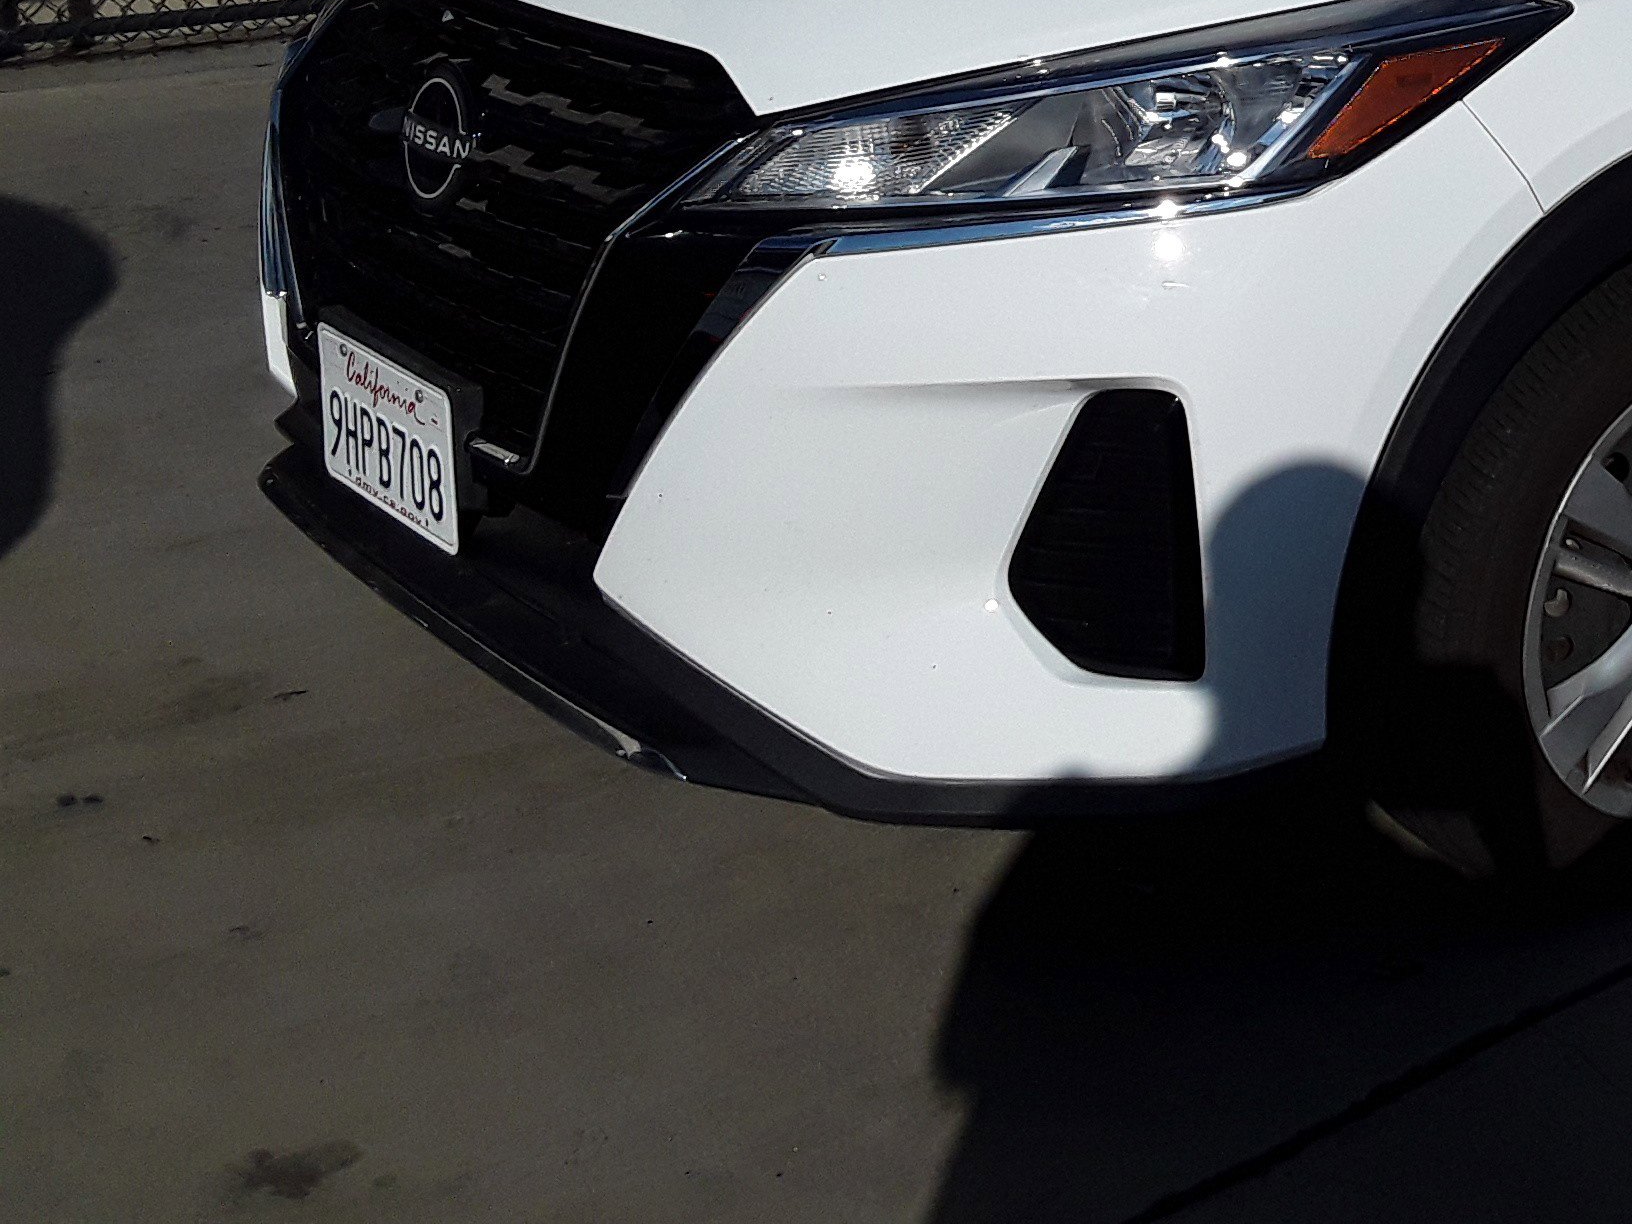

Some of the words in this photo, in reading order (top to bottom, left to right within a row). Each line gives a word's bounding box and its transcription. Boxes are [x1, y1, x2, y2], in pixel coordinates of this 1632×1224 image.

[403, 116, 470, 159] NISSAN
[346, 351, 426, 426] California
[330, 389, 443, 521] 9HPB708
